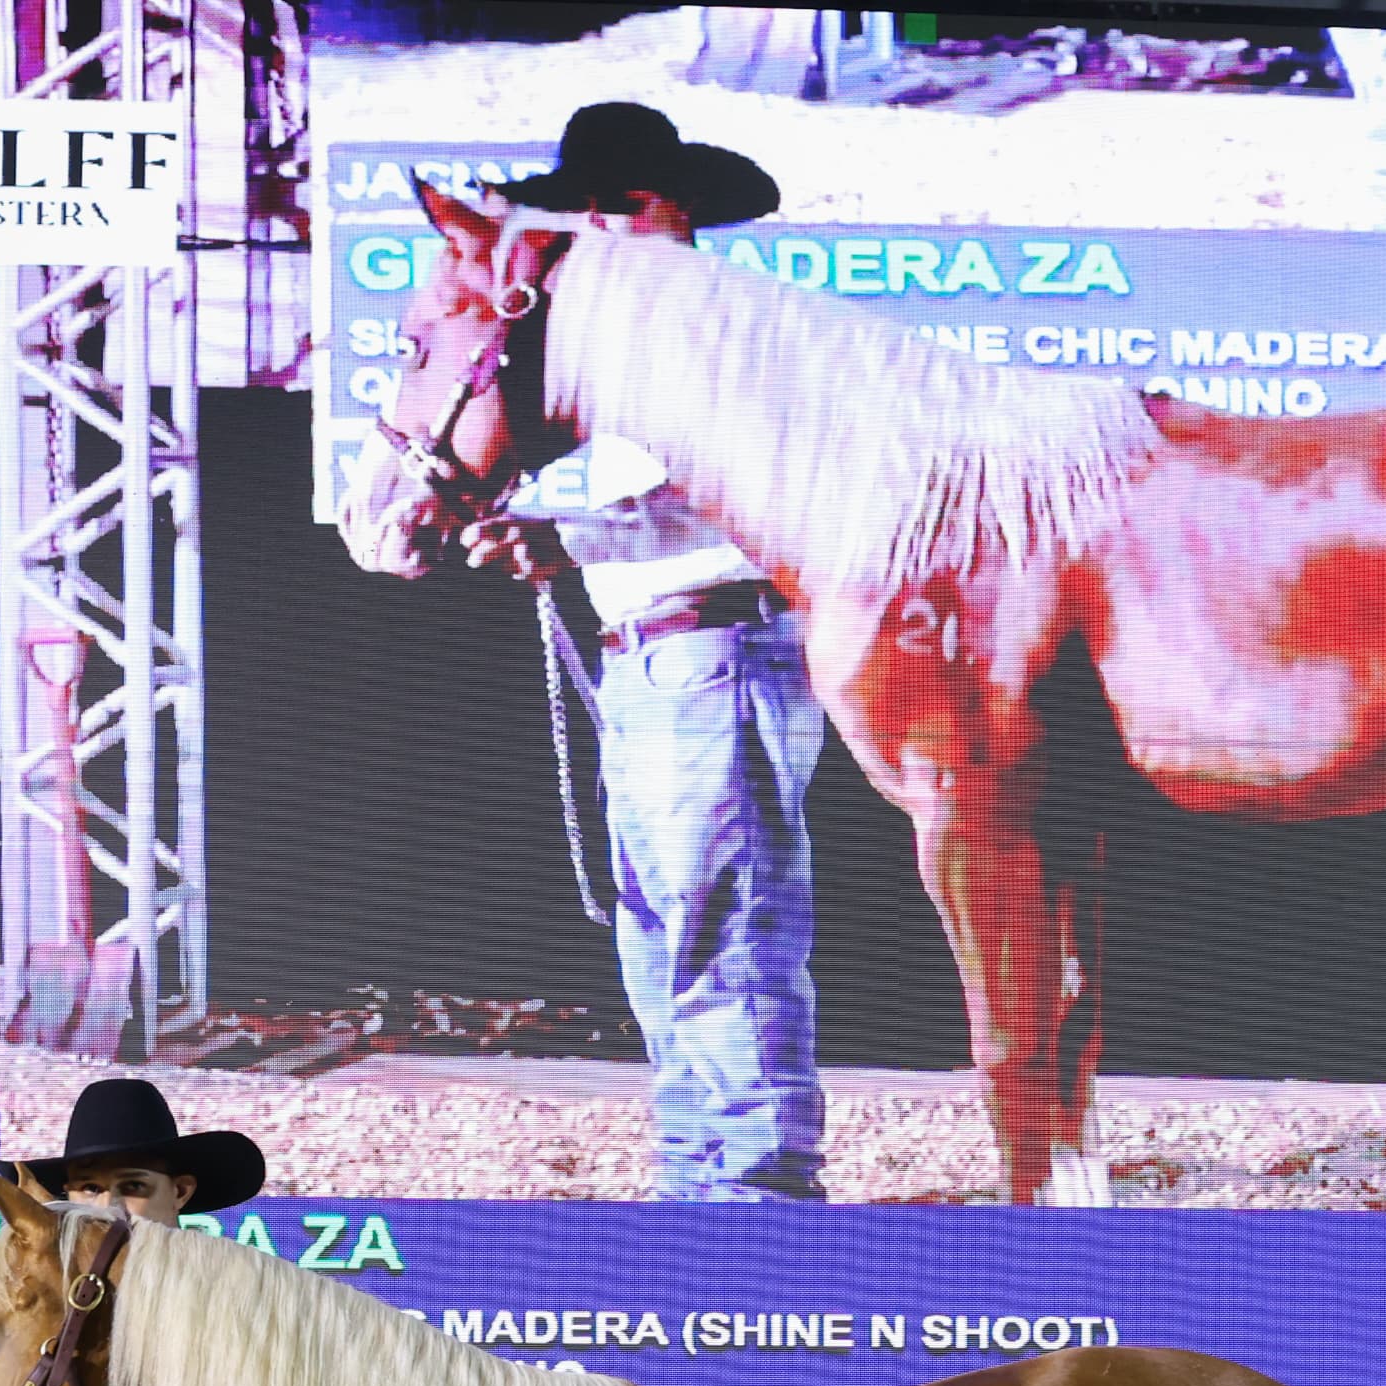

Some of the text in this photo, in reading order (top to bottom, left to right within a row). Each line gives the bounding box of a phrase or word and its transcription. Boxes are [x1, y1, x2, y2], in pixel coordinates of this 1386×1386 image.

[1018, 241, 1131, 295] ZA
[1024, 326, 1157, 366] CHIC
[298, 1215, 405, 1270] ZA
[442, 1310, 1119, 1355] MADERA (SHINE N SHOOT)
